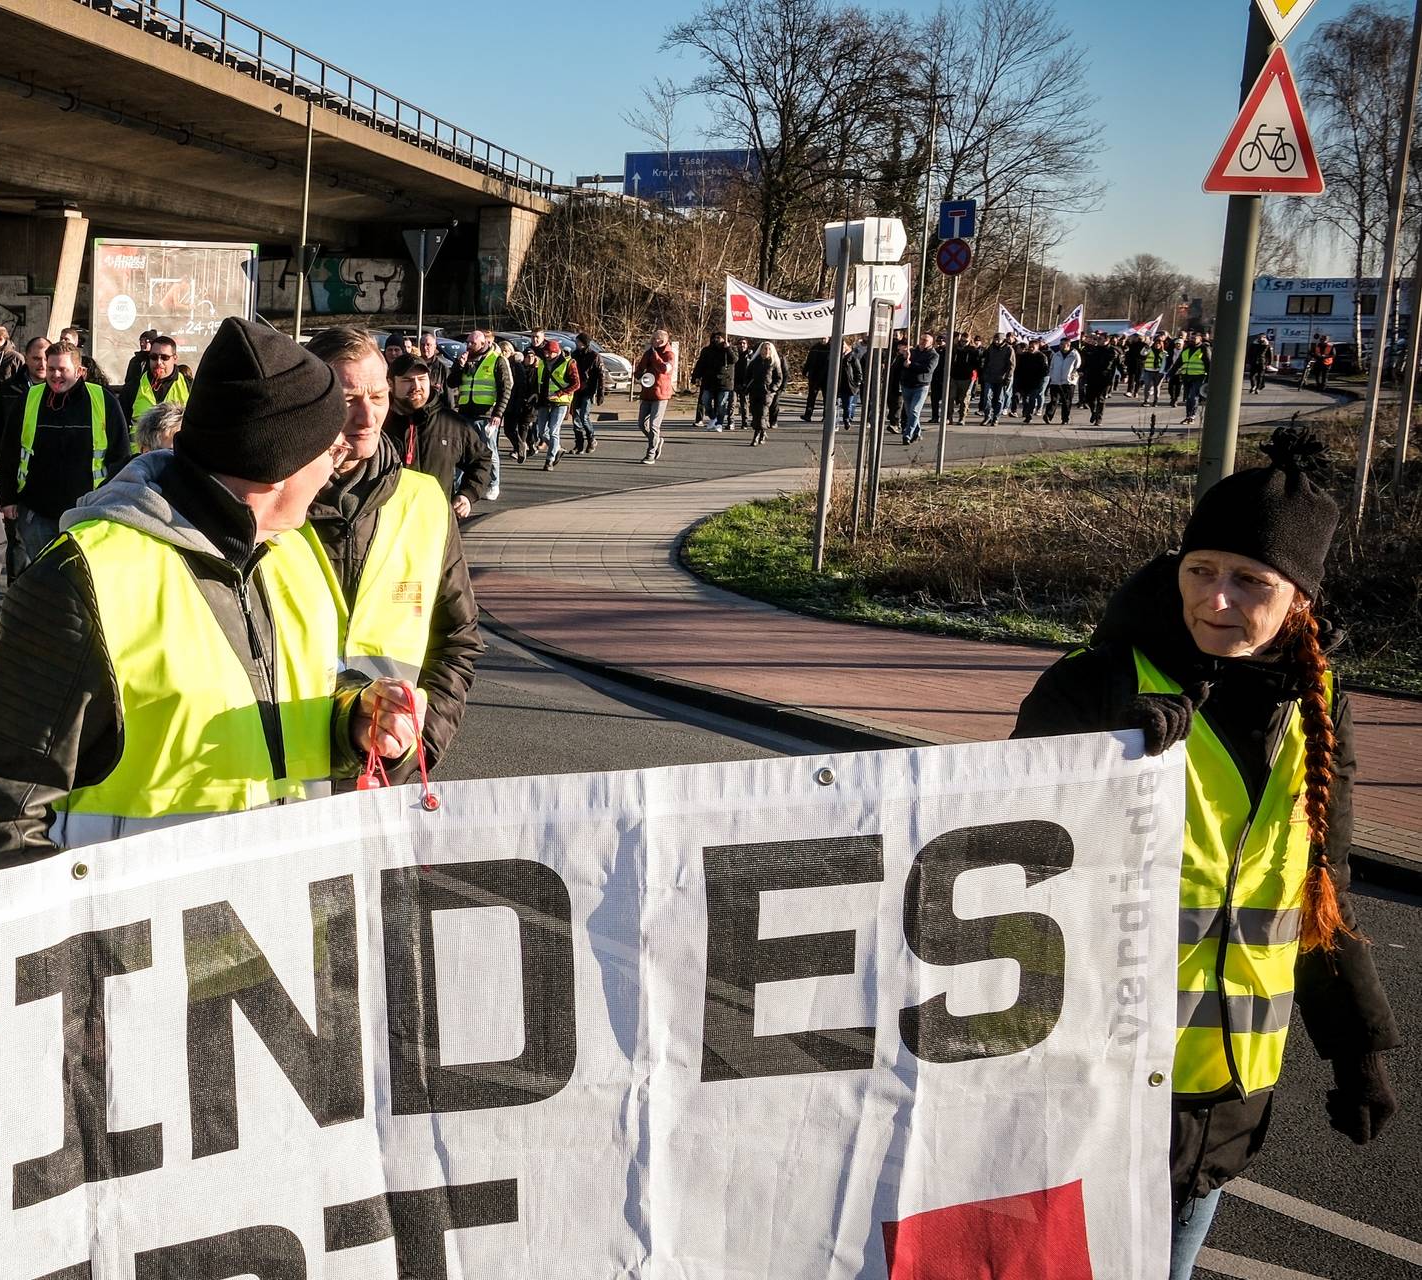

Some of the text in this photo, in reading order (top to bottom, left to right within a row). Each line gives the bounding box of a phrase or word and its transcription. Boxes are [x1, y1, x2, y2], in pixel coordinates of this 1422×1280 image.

[652, 168, 679, 177] Kreuz
[1299, 278, 1348, 292] Siegfried
[1225, 290, 1234, 302] 6
[764, 301, 856, 321] Wir streikn
[700, 819, 1075, 1083] ES
